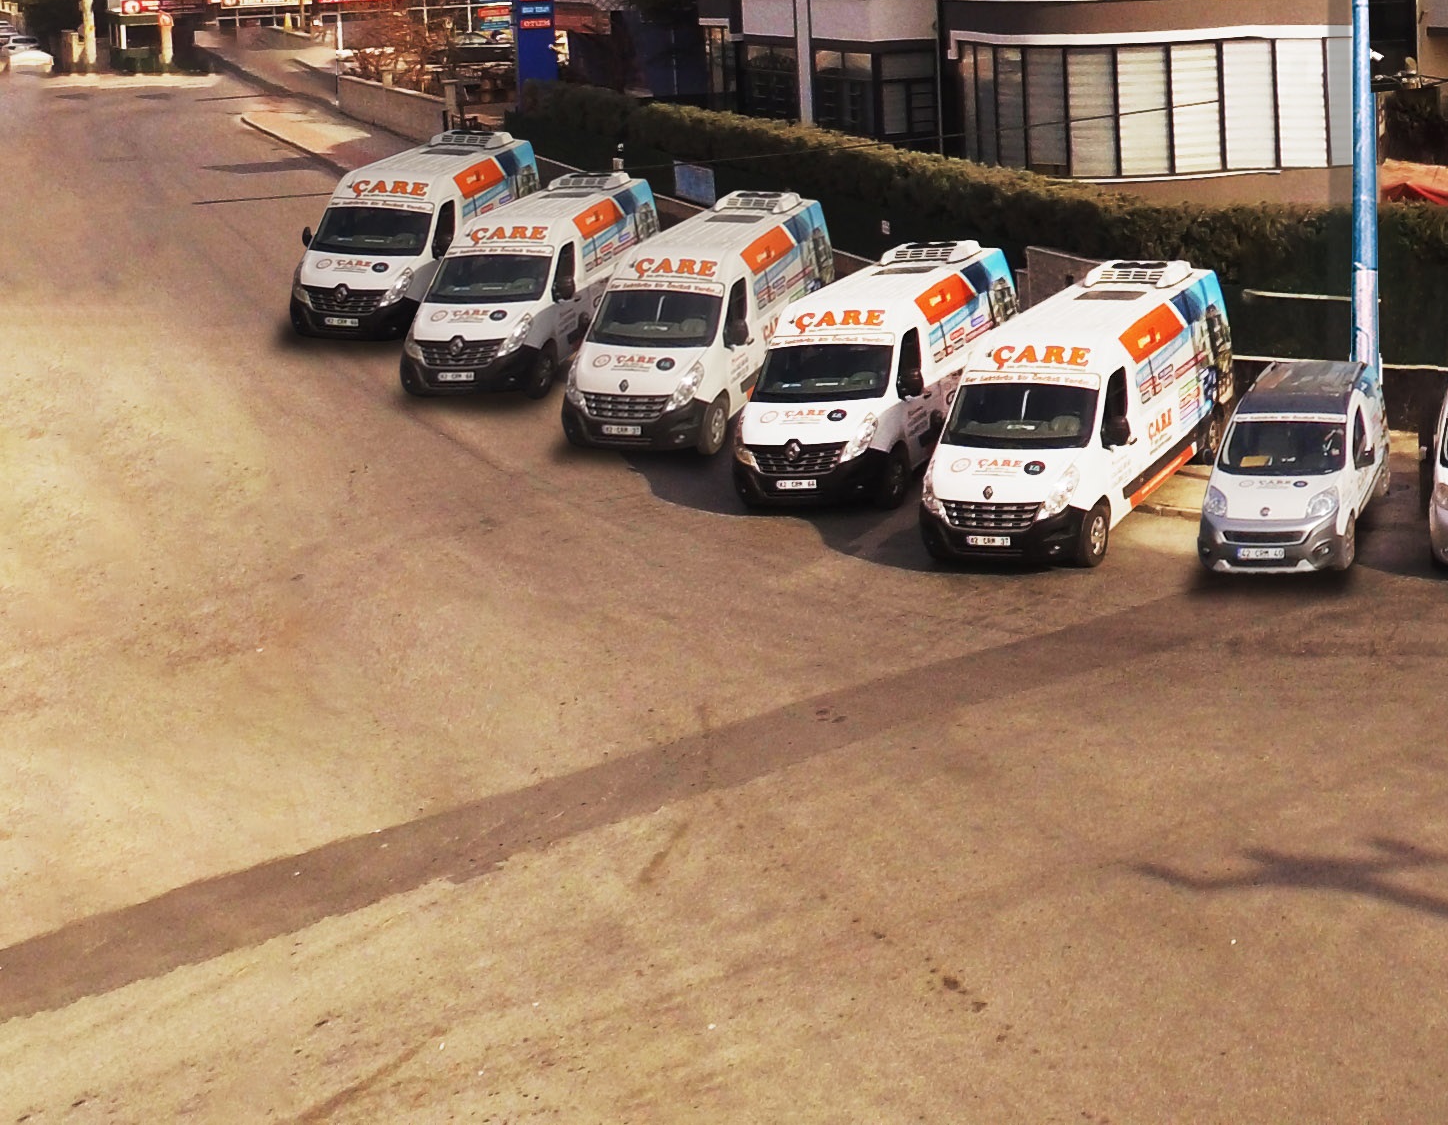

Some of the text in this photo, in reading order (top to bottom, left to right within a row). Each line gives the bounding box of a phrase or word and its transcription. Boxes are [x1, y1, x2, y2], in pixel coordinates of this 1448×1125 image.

[352, 180, 429, 199] ÇARE
[470, 226, 548, 247] ÇARE
[635, 258, 718, 279] ÇARE
[795, 309, 885, 335] ÇARE
[993, 345, 1091, 370] ÇARE
